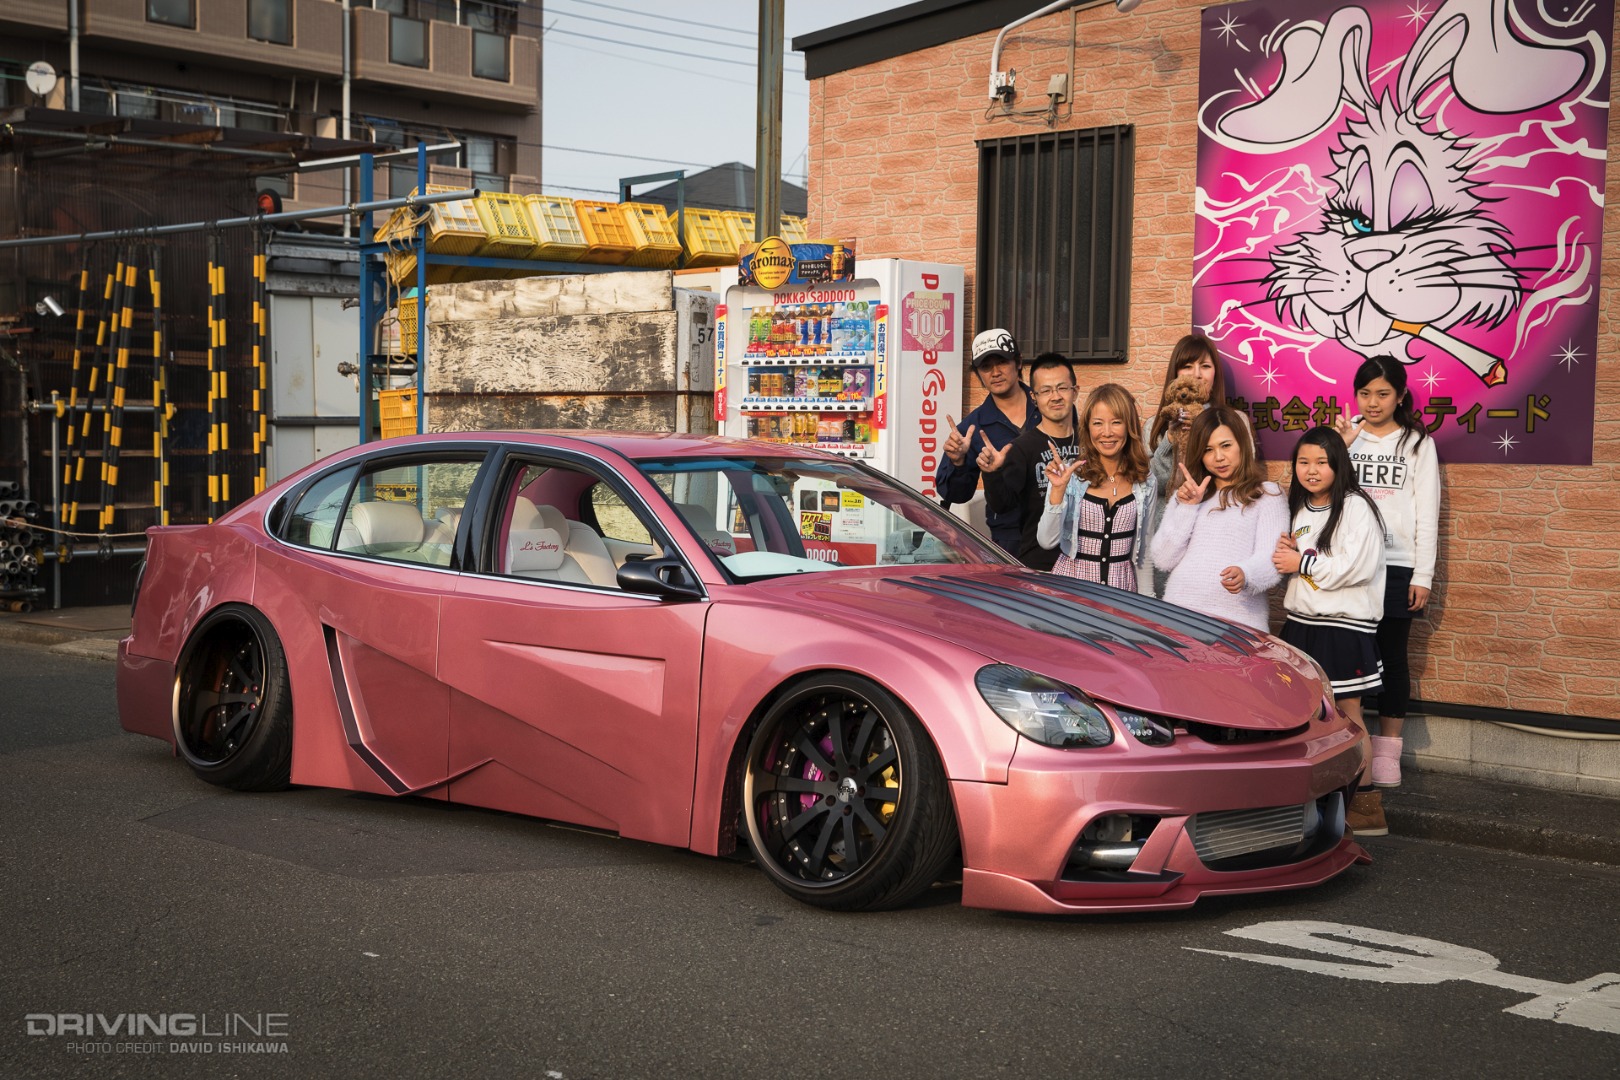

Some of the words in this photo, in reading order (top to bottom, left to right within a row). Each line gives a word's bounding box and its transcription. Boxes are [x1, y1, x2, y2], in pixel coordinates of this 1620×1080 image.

[750, 256, 795, 270] aromax
[810, 289, 856, 304] sapporo
[906, 298, 928, 309] PRICE
[929, 299, 950, 310] DOWN
[908, 309, 946, 338] 100
[698, 327, 714, 344] 57
[1414, 394, 1551, 433] ティード
[1348, 452, 1374, 462] LOOK
[1377, 454, 1406, 464] OVER
